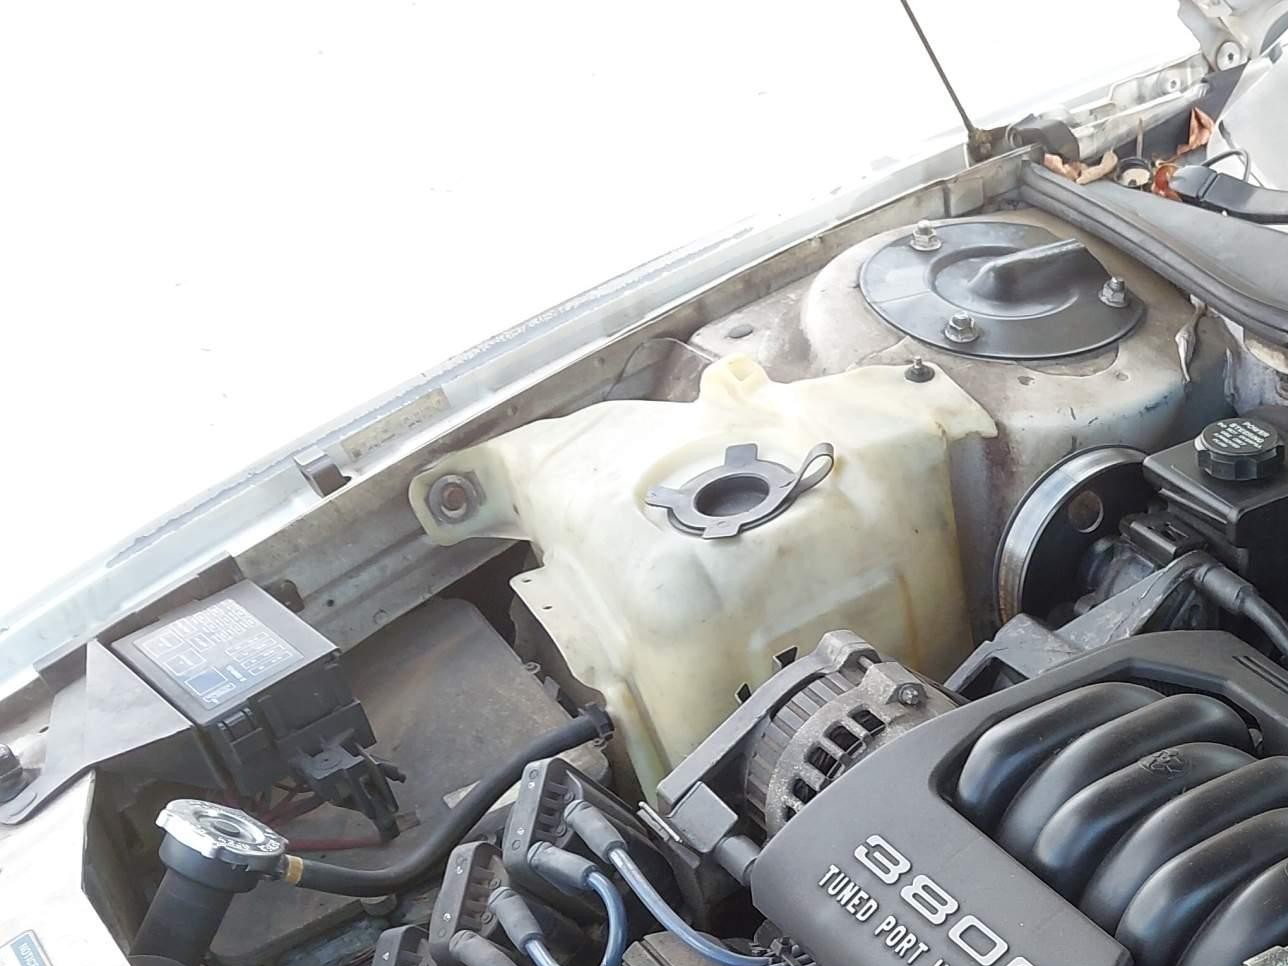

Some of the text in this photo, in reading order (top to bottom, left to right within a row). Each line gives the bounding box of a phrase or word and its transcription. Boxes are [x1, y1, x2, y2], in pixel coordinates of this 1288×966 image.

[1229, 422, 1264, 443] STEERING
[1243, 421, 1270, 438] POWER
[817, 864, 874, 923] TUNED
[874, 913, 929, 966] PORT
